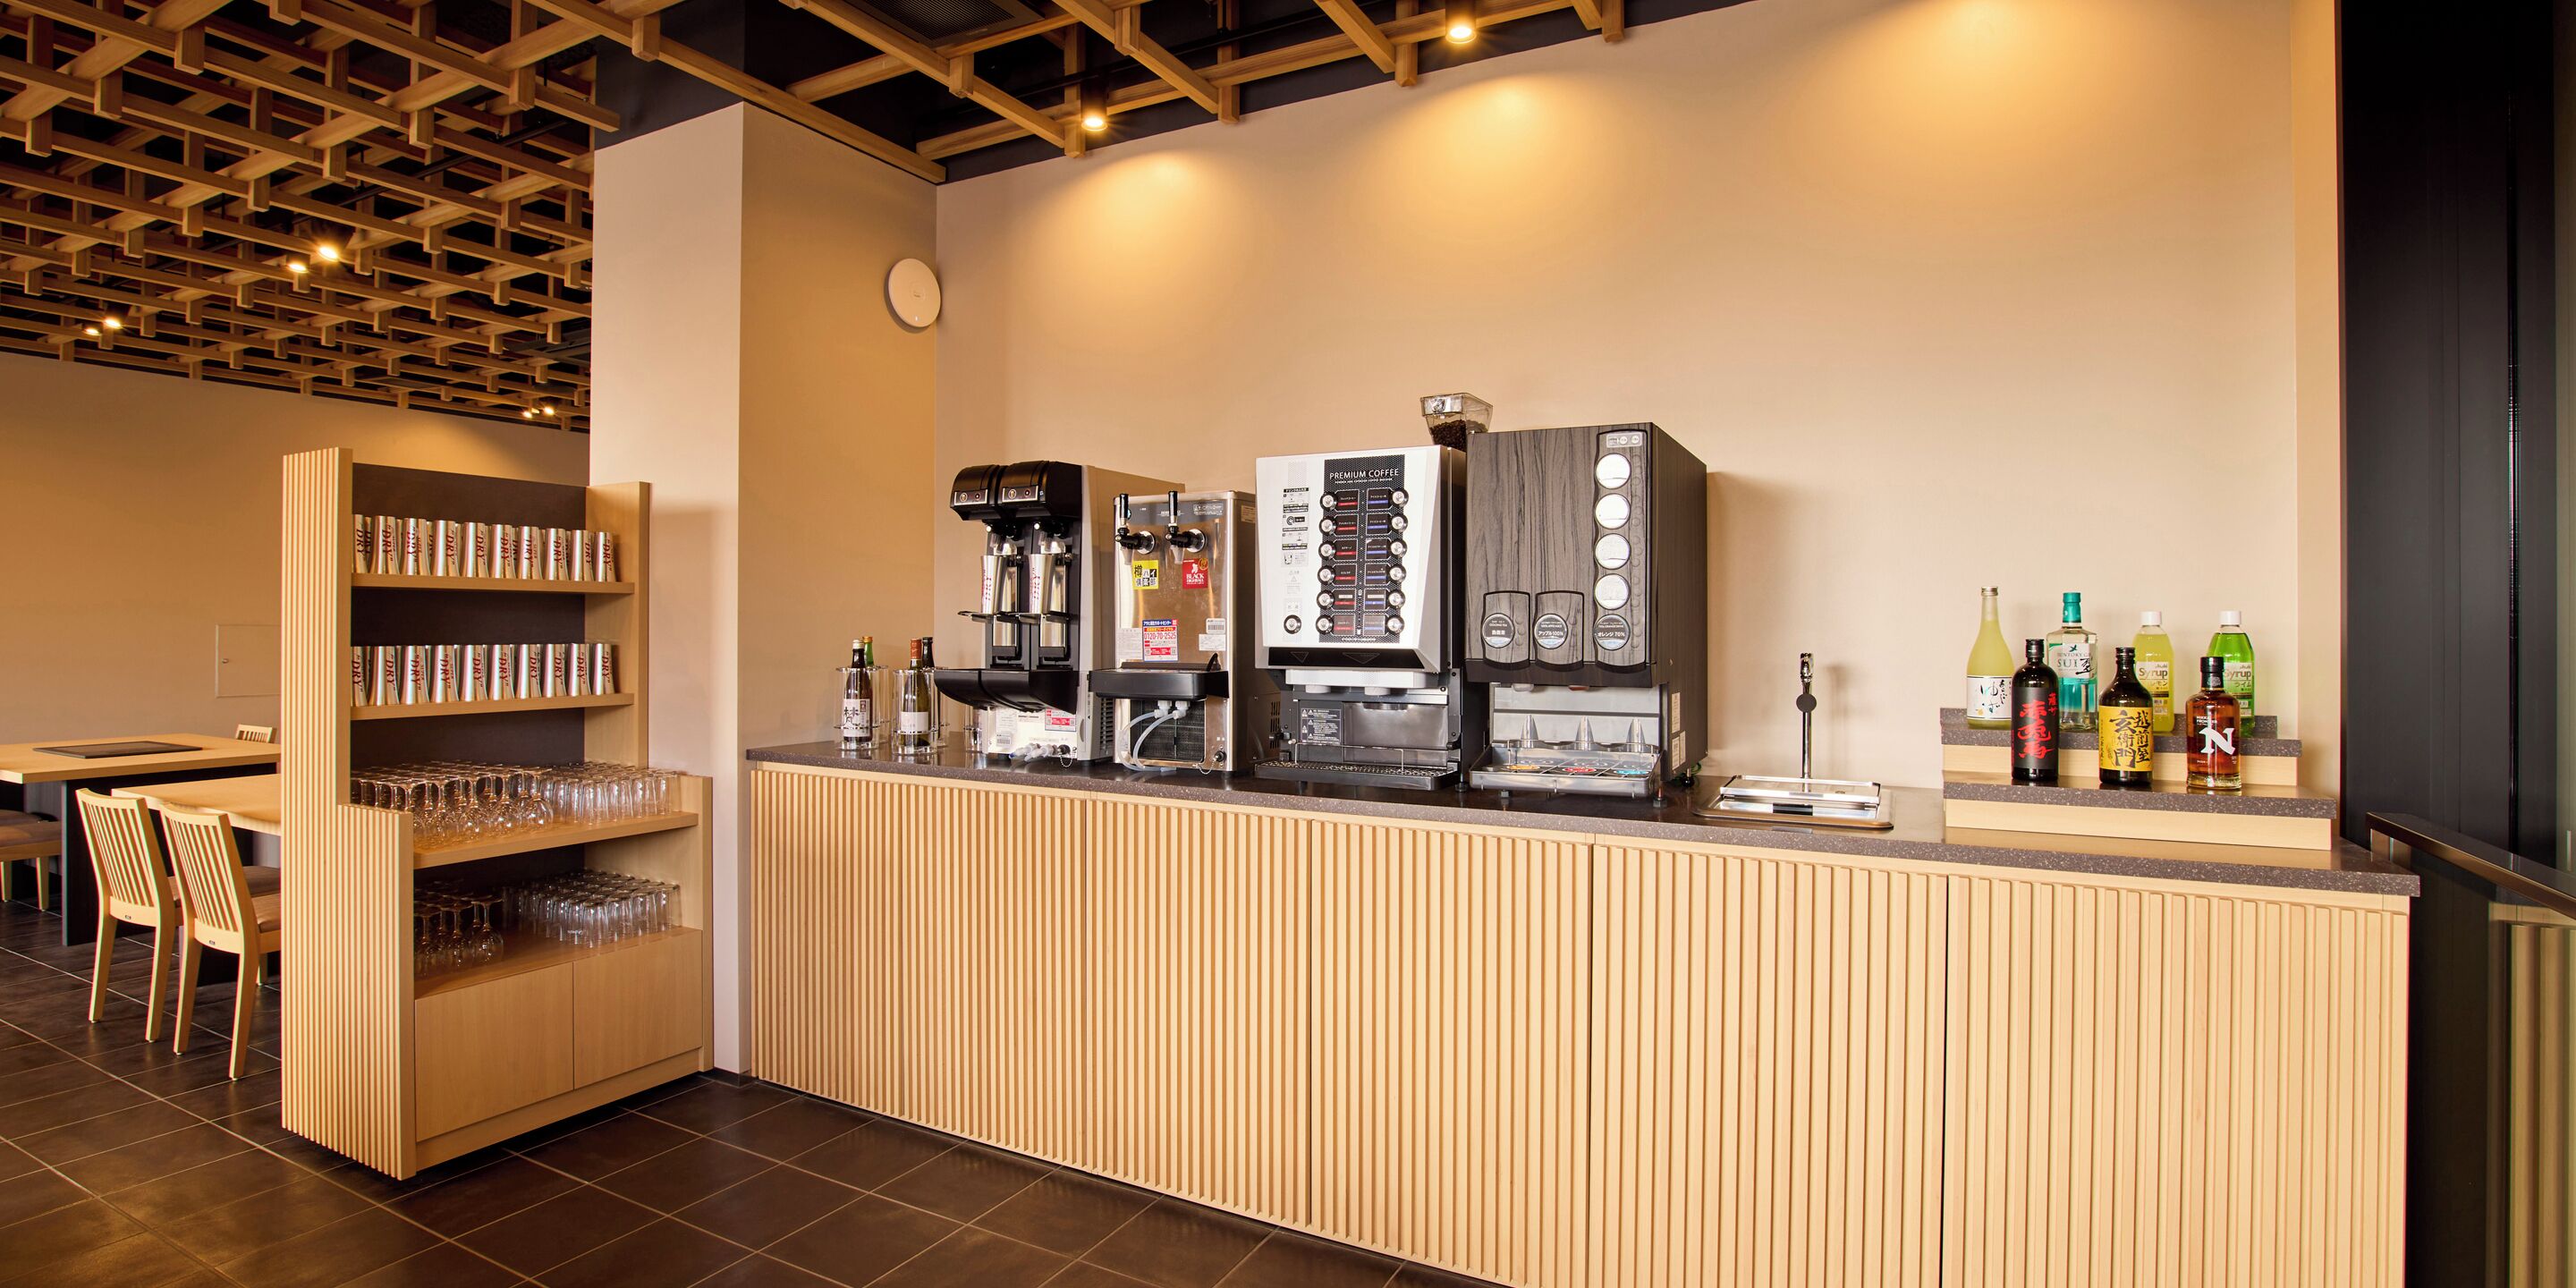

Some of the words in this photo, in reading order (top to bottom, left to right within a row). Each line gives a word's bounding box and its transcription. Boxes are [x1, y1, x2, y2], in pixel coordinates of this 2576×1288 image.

[1329, 470, 1366, 480] PREMIUM
[1368, 468, 1399, 477] COFFEE
[2058, 658, 2078, 667] SUI
[2139, 667, 2168, 679] Syrup
[2224, 670, 2251, 680] Syrup
[2199, 727, 2236, 755] N
